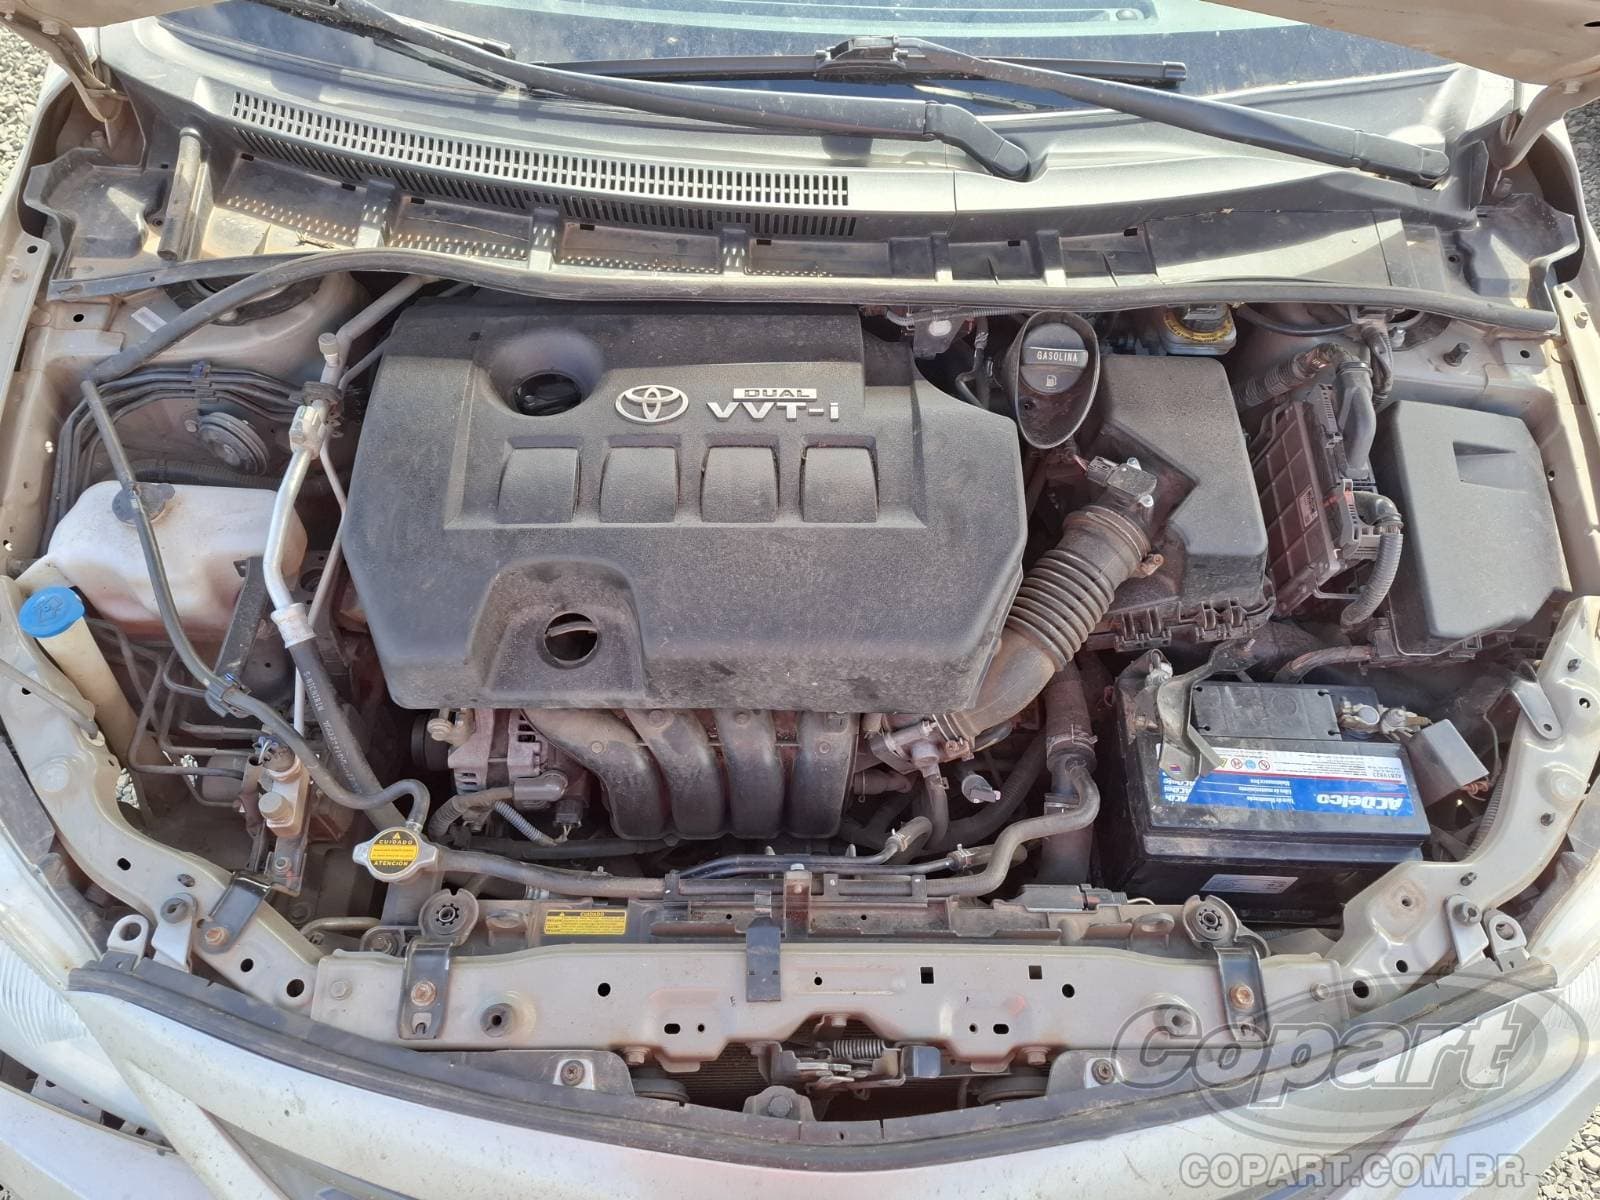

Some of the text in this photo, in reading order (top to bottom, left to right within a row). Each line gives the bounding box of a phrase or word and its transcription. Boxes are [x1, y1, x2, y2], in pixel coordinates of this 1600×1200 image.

[1036, 350, 1078, 362] GASOLINA
[743, 389, 811, 398] DUAL
[706, 401, 839, 422] VVT-i
[1316, 793, 1404, 811] ACDelco
